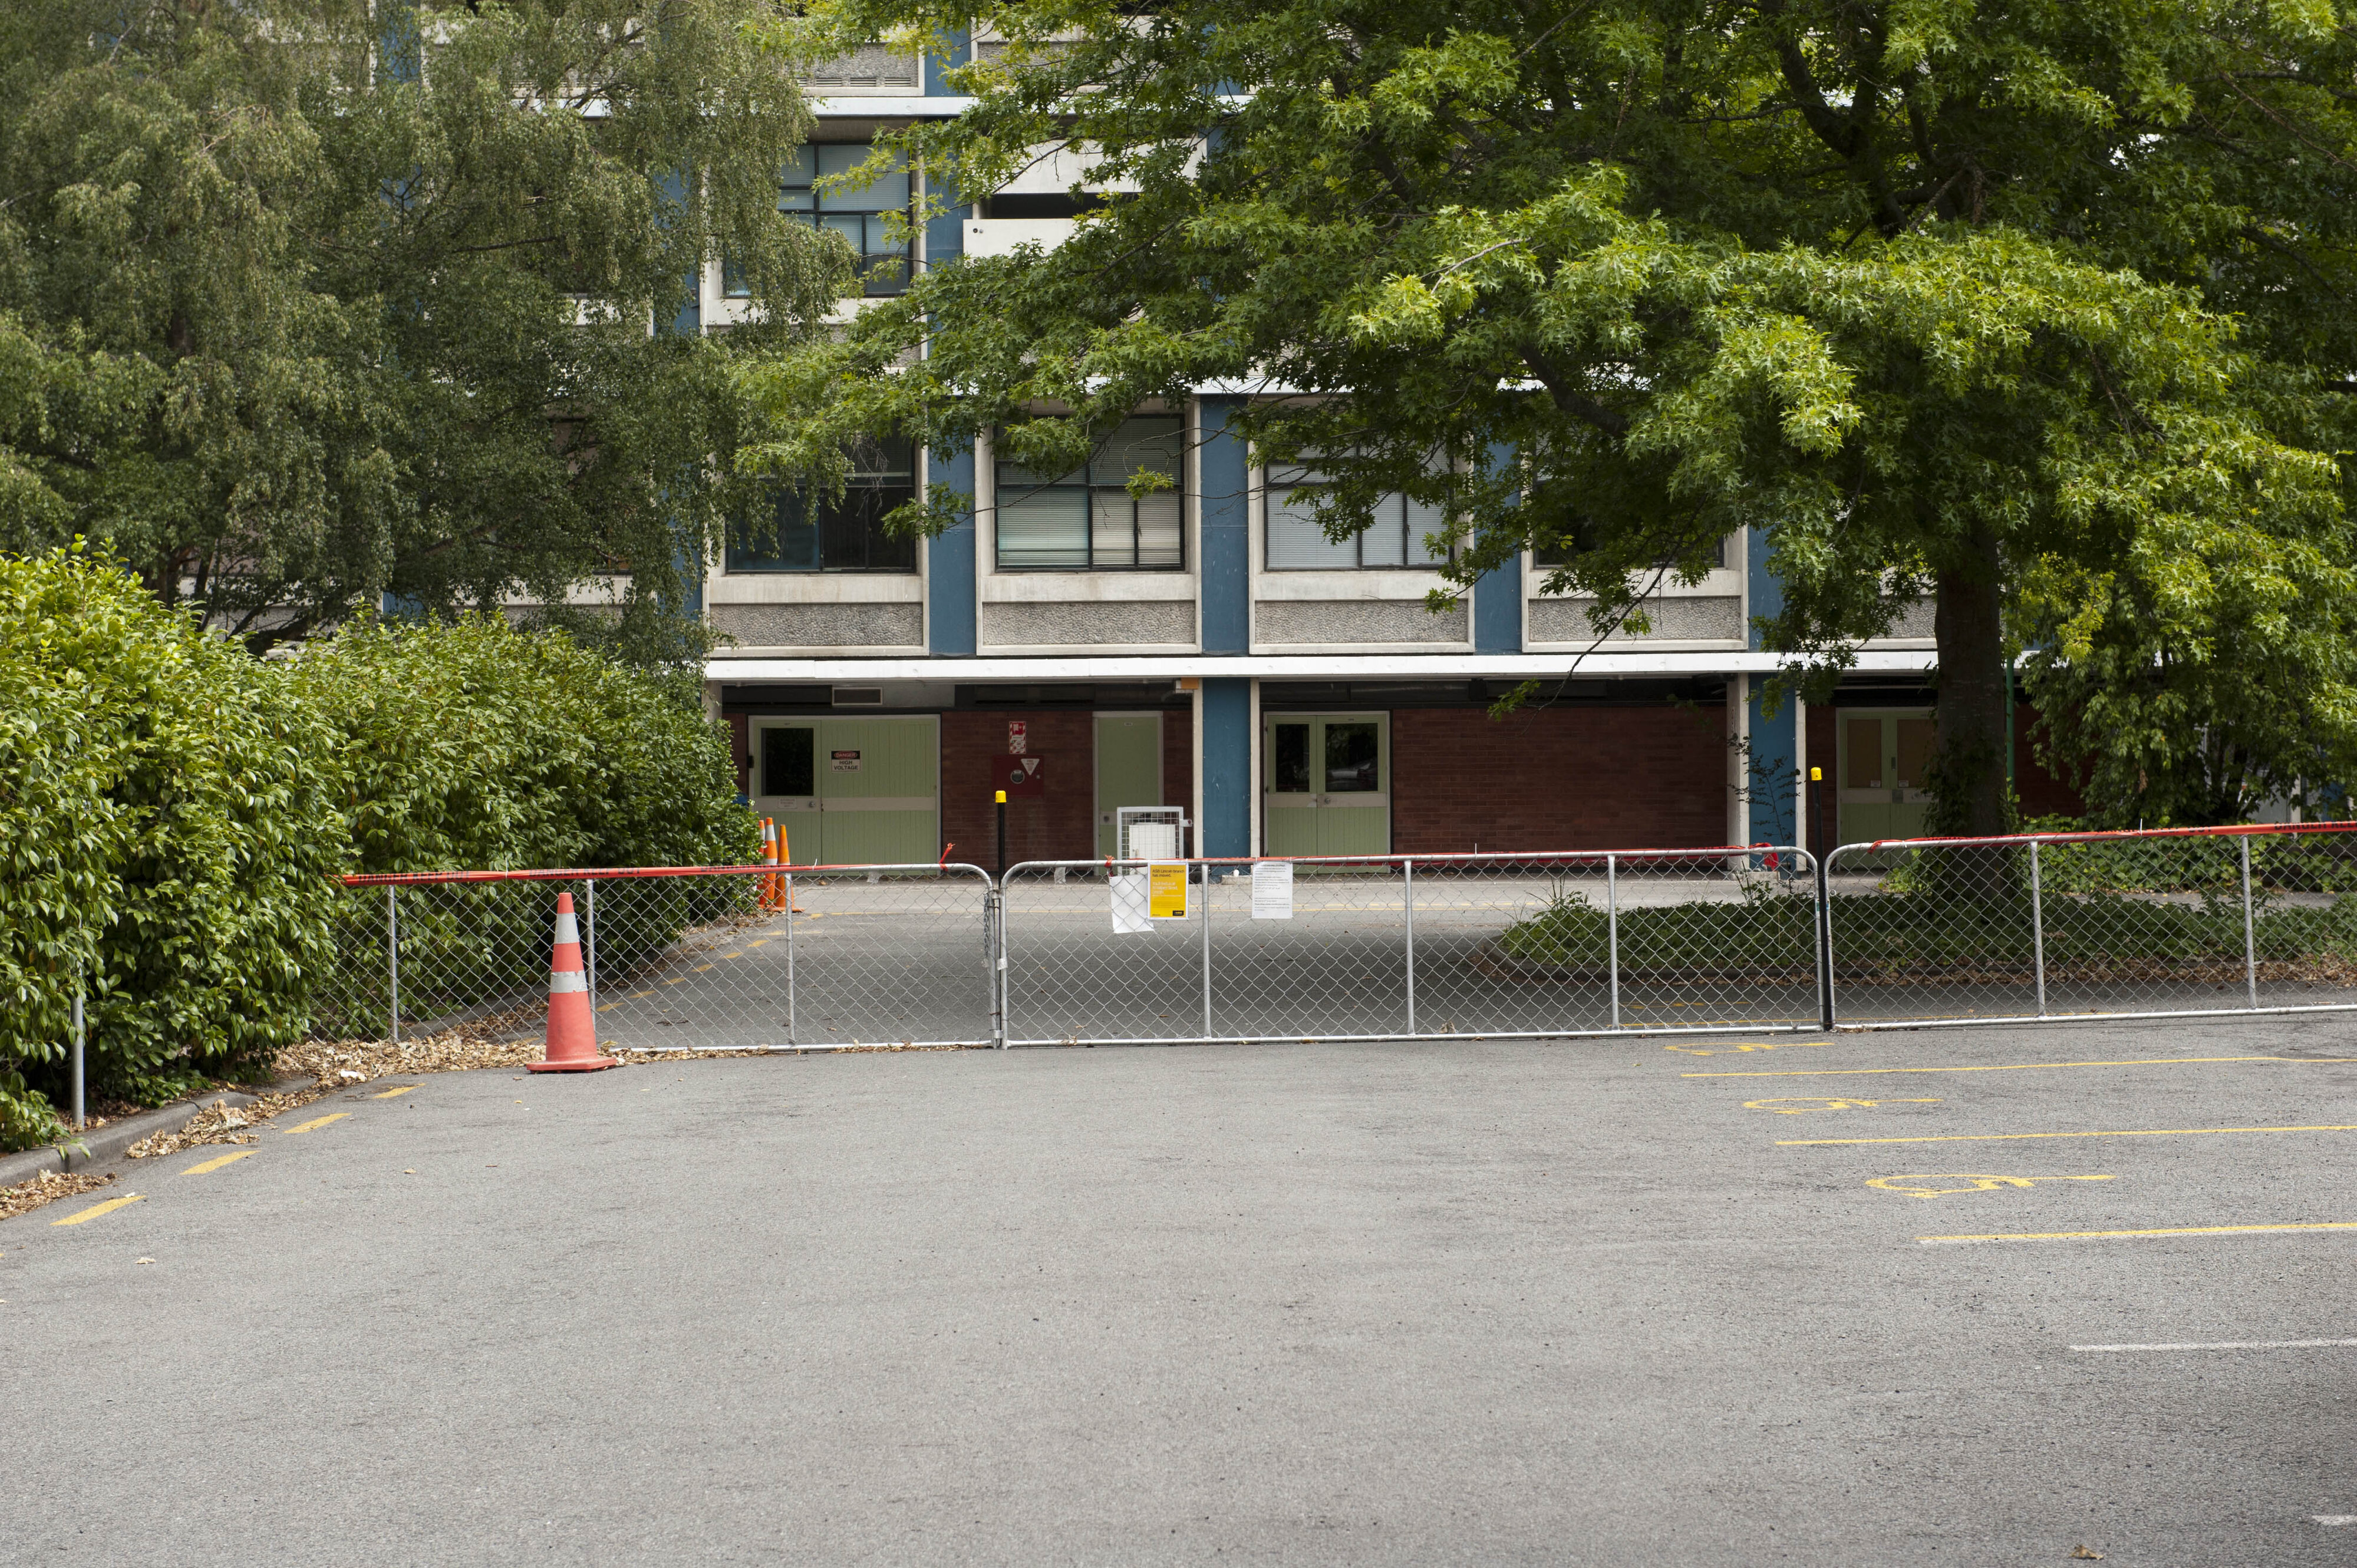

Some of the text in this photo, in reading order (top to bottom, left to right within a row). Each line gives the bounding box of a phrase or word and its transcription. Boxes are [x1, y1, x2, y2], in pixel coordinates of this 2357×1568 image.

[358, 871, 470, 882] DANGER KEEP OUT
